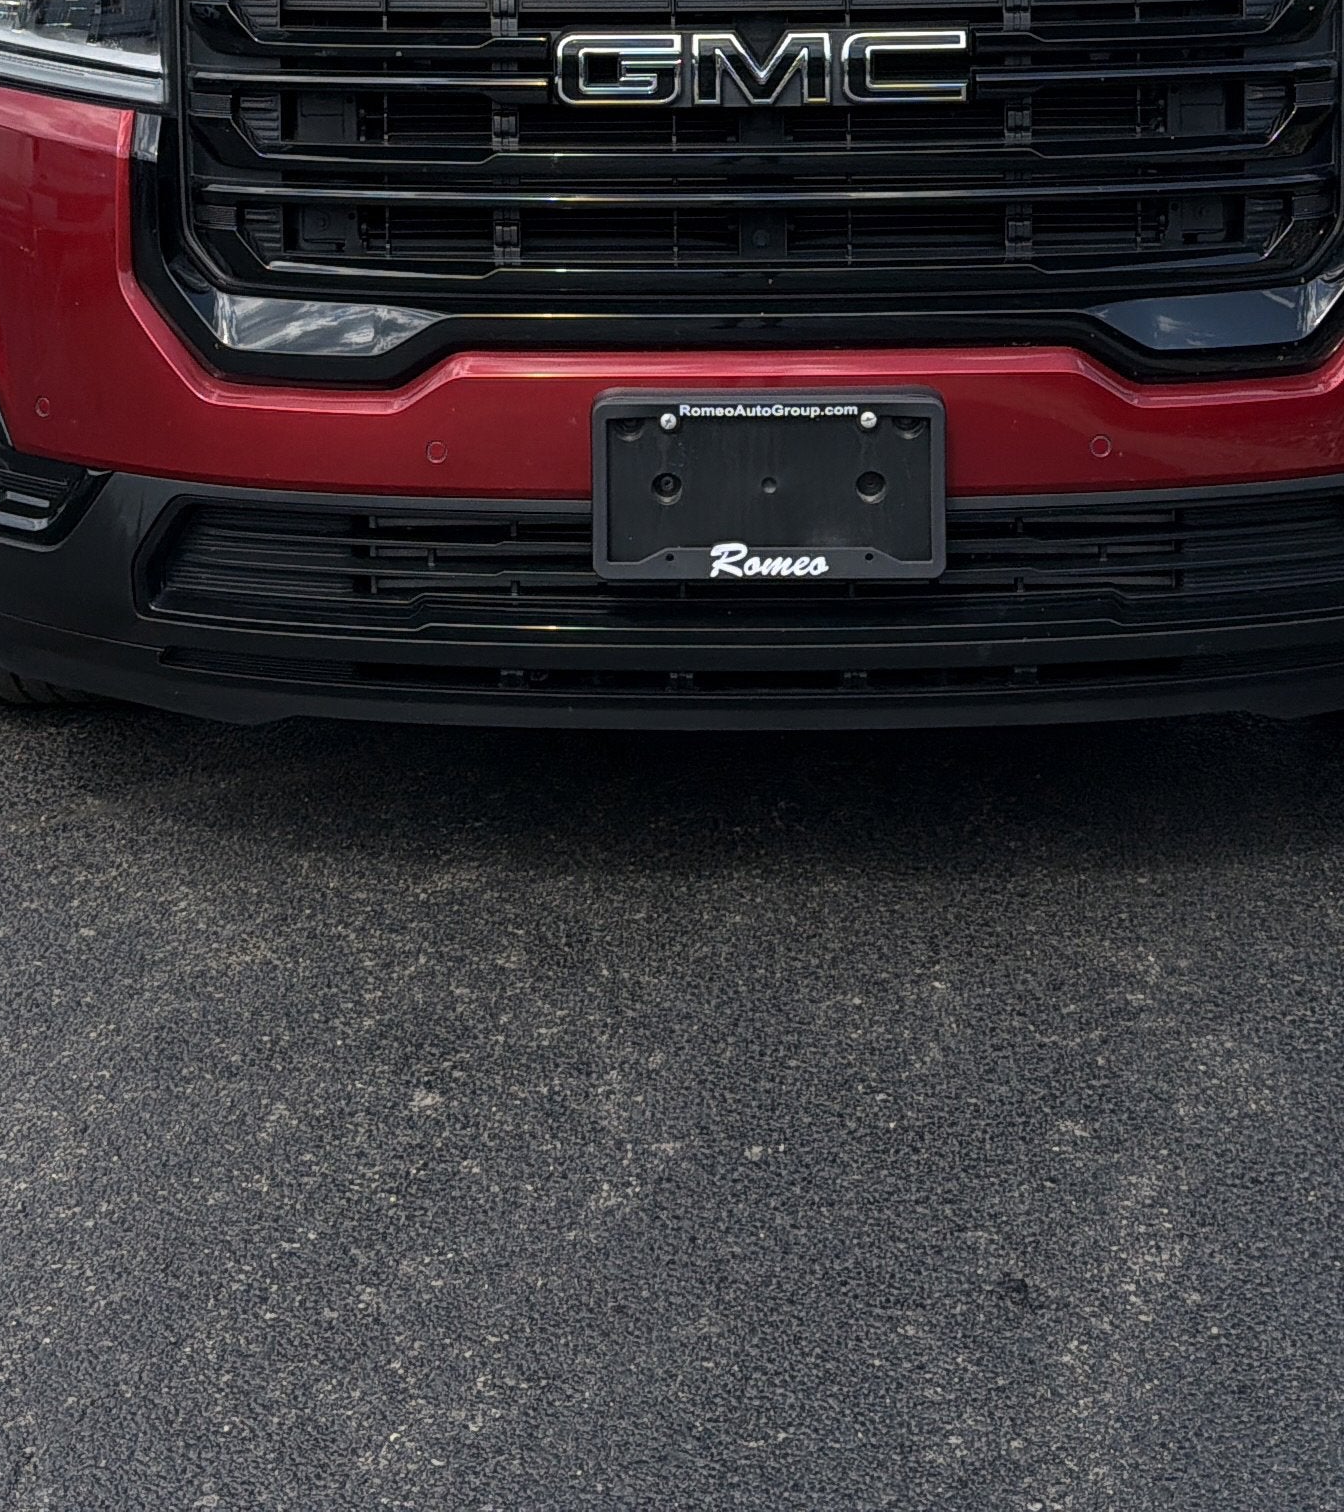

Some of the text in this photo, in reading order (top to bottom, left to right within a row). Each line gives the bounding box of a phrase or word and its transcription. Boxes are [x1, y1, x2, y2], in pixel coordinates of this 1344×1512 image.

[556, 30, 968, 106] GMC
[679, 404, 858, 418] RomeoAutoGroup.com
[709, 542, 830, 578] Romeo
